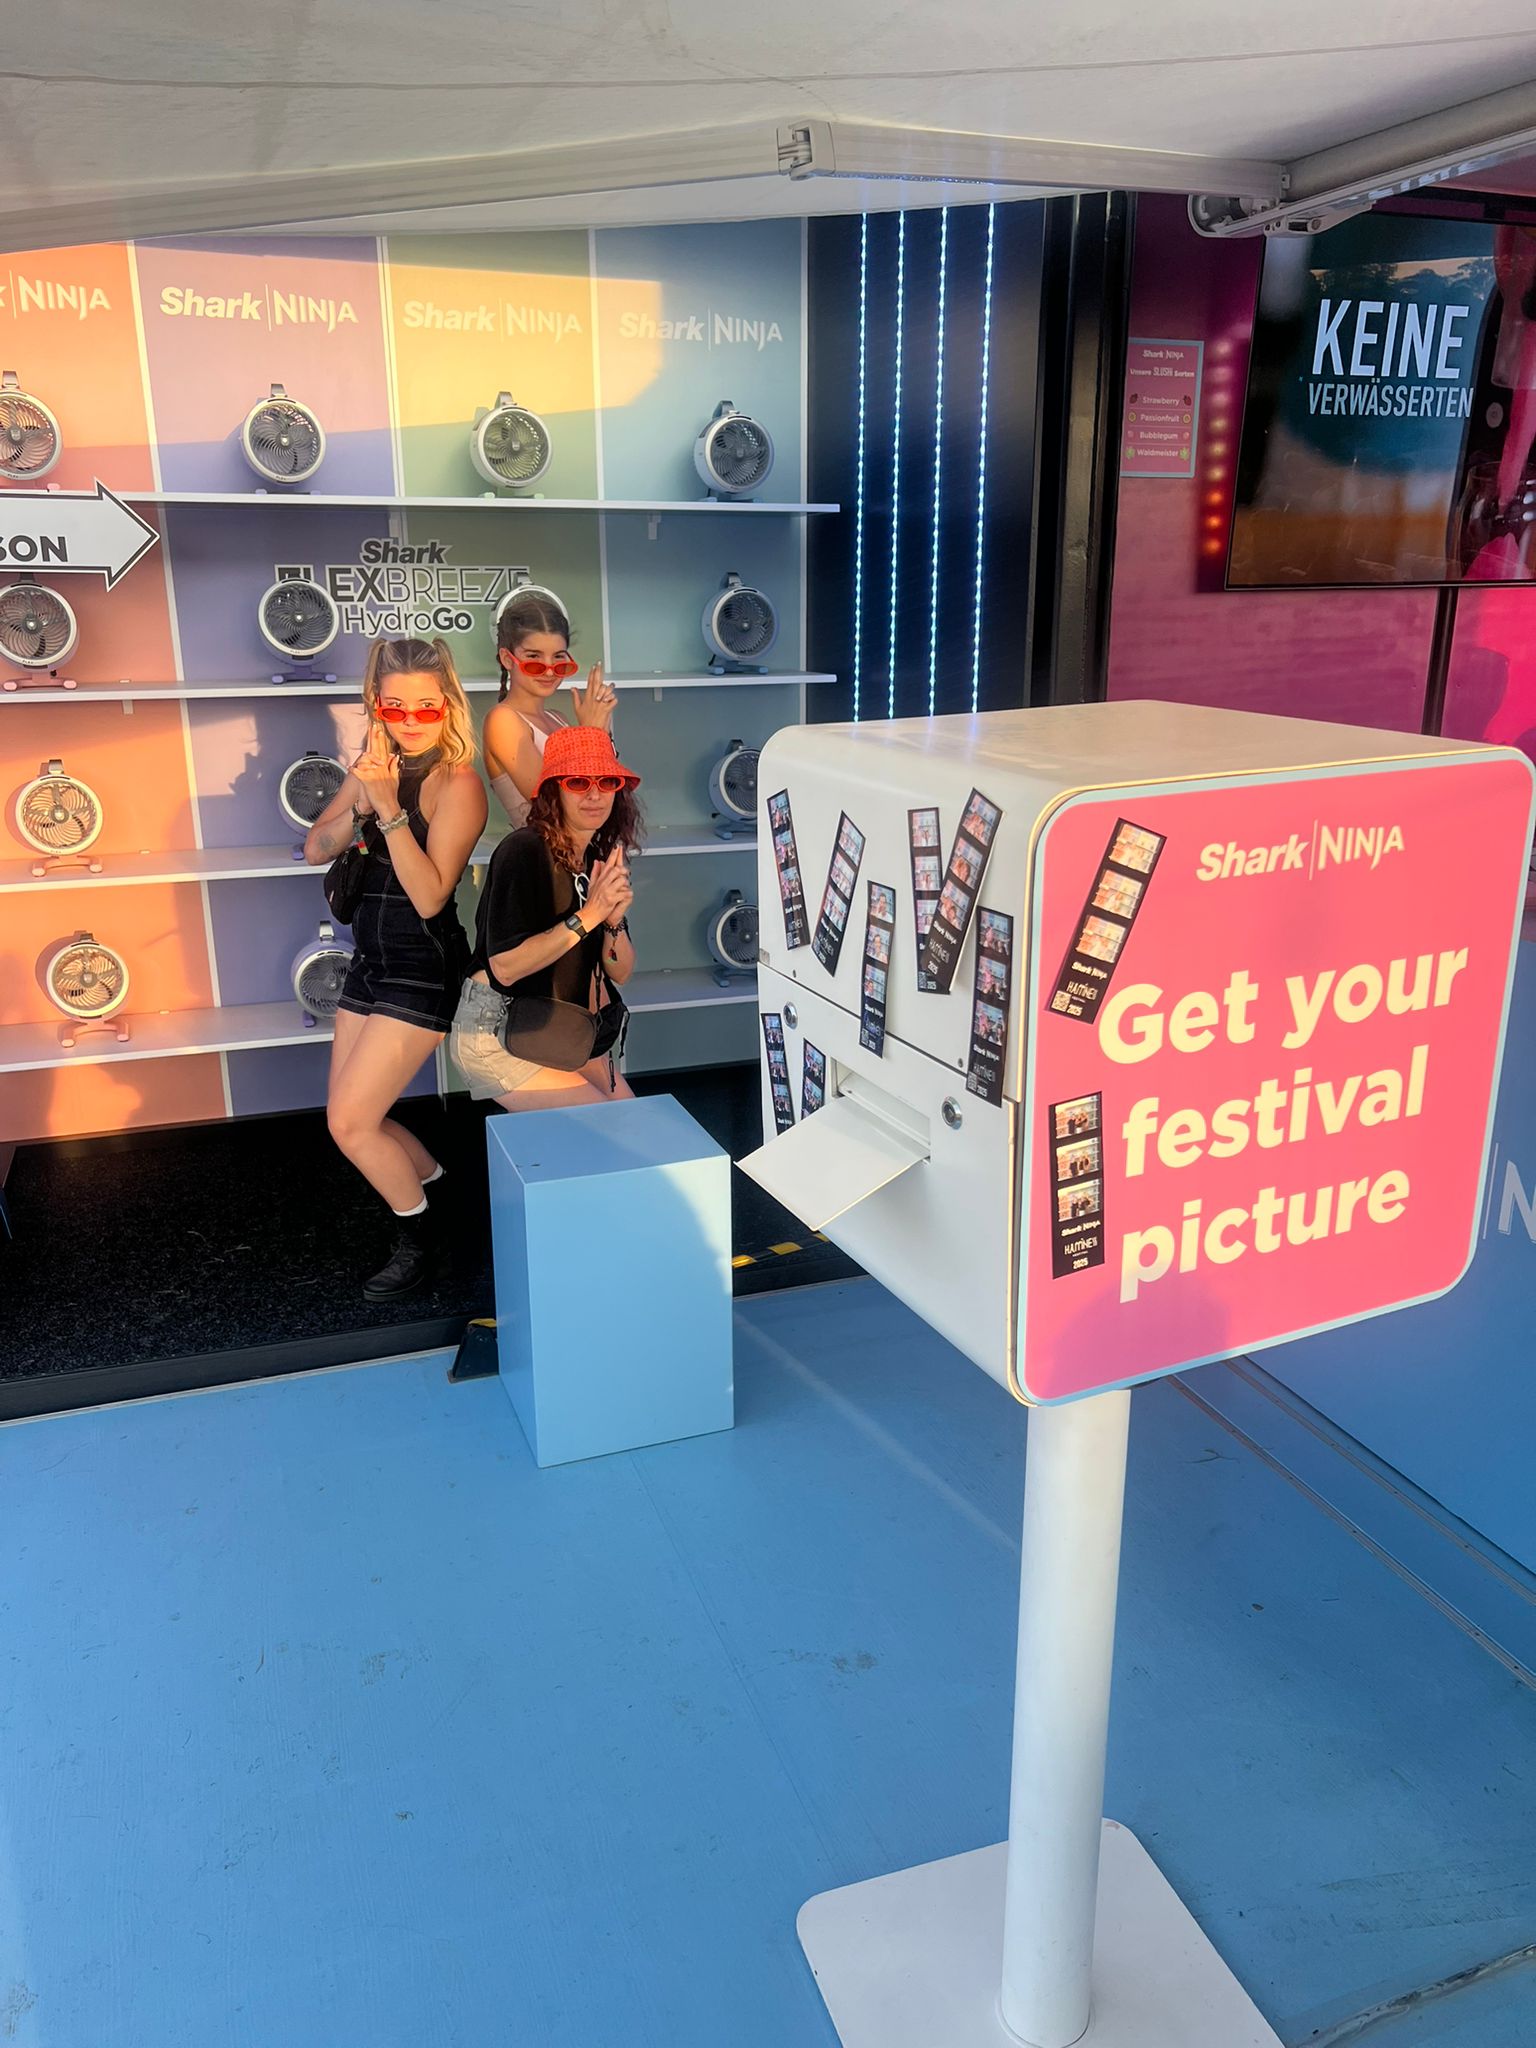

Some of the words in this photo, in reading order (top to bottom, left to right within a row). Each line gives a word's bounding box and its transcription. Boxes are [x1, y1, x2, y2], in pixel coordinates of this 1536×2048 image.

[18, 275, 113, 321] NINJA
[159, 286, 264, 321] Shark
[273, 289, 360, 334] NINJA
[402, 299, 497, 333] Shark
[505, 303, 583, 345] NINJA
[618, 311, 705, 342] Shark
[714, 313, 784, 352] NINJA
[1312, 298, 1470, 380] KEINE
[1140, 413, 1180, 423] Passionfruit
[1142, 396, 1180, 407] Strawberry
[1308, 377, 1475, 419] VERWÄSSERTEN
[1137, 448, 1179, 458] Waldmeister
[1139, 431, 1179, 441] Bubblegum
[362, 539, 447, 564] Shark
[344, 605, 473, 636] HydroGo
[1196, 833, 1310, 882] Shark
[1317, 824, 1406, 871] NINJA
[1098, 969, 1260, 1065] Get
[1280, 946, 1470, 1050] your
[1121, 1043, 1430, 1179] festival
[1119, 1169, 1411, 1305] picture
